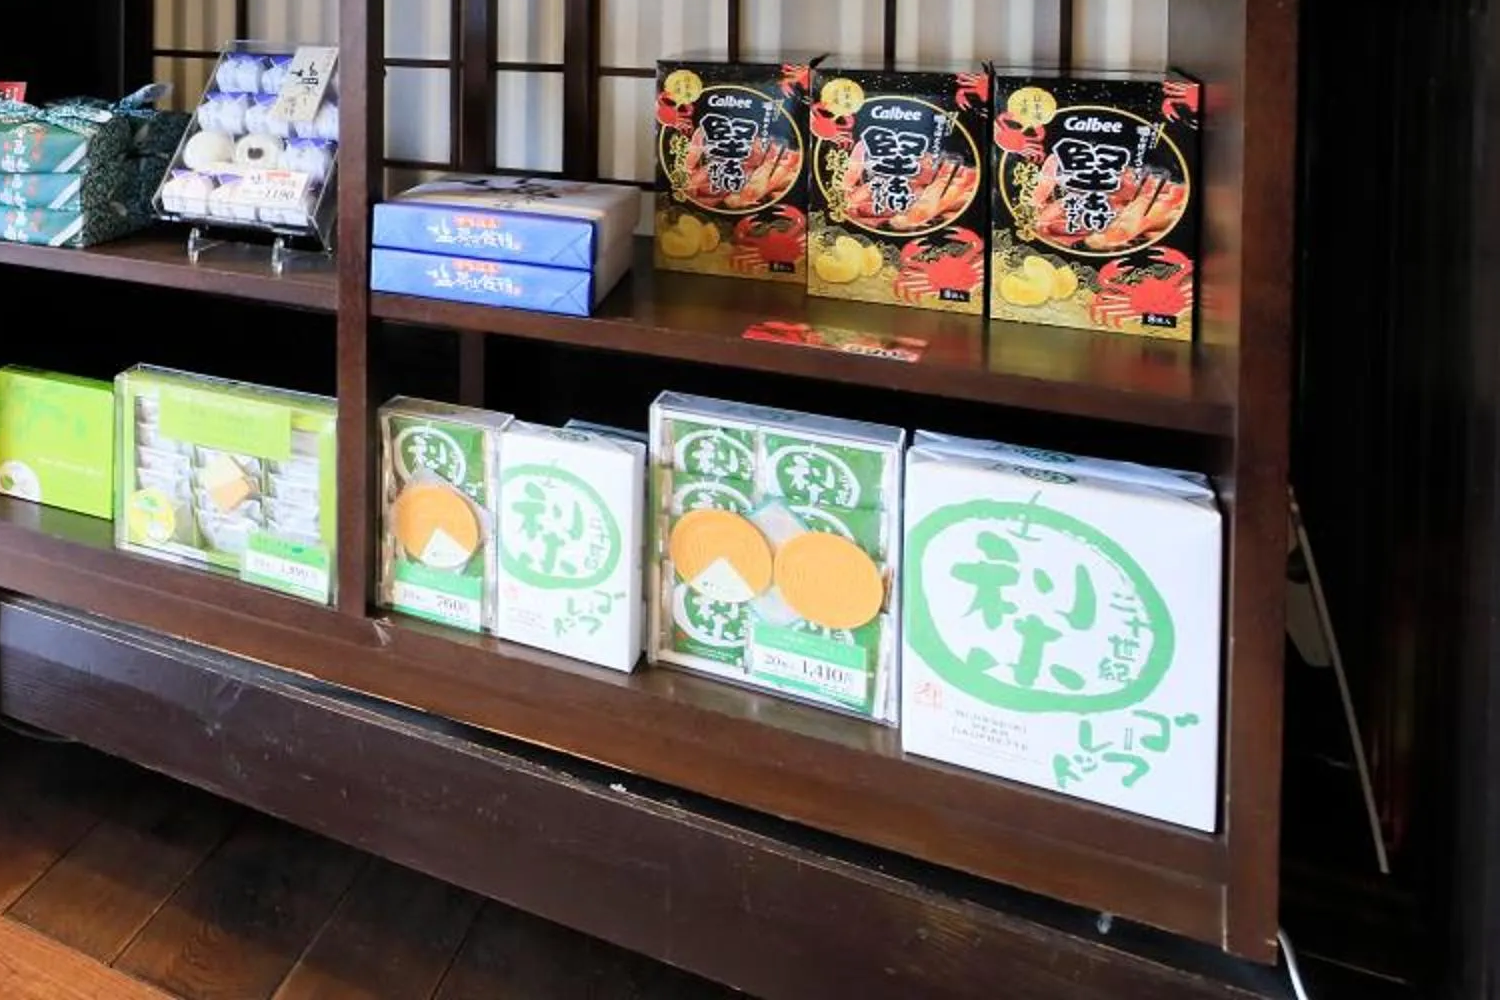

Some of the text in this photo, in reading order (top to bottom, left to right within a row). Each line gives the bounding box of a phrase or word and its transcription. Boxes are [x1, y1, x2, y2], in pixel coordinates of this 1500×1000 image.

[707, 94, 753, 109] Calbee
[871, 105, 922, 121] Calbee
[1063, 116, 1123, 134] Calbee
[511, 482, 584, 576] 梨
[950, 530, 1098, 692] 梨
[1098, 592, 1153, 683] 二十世紀
